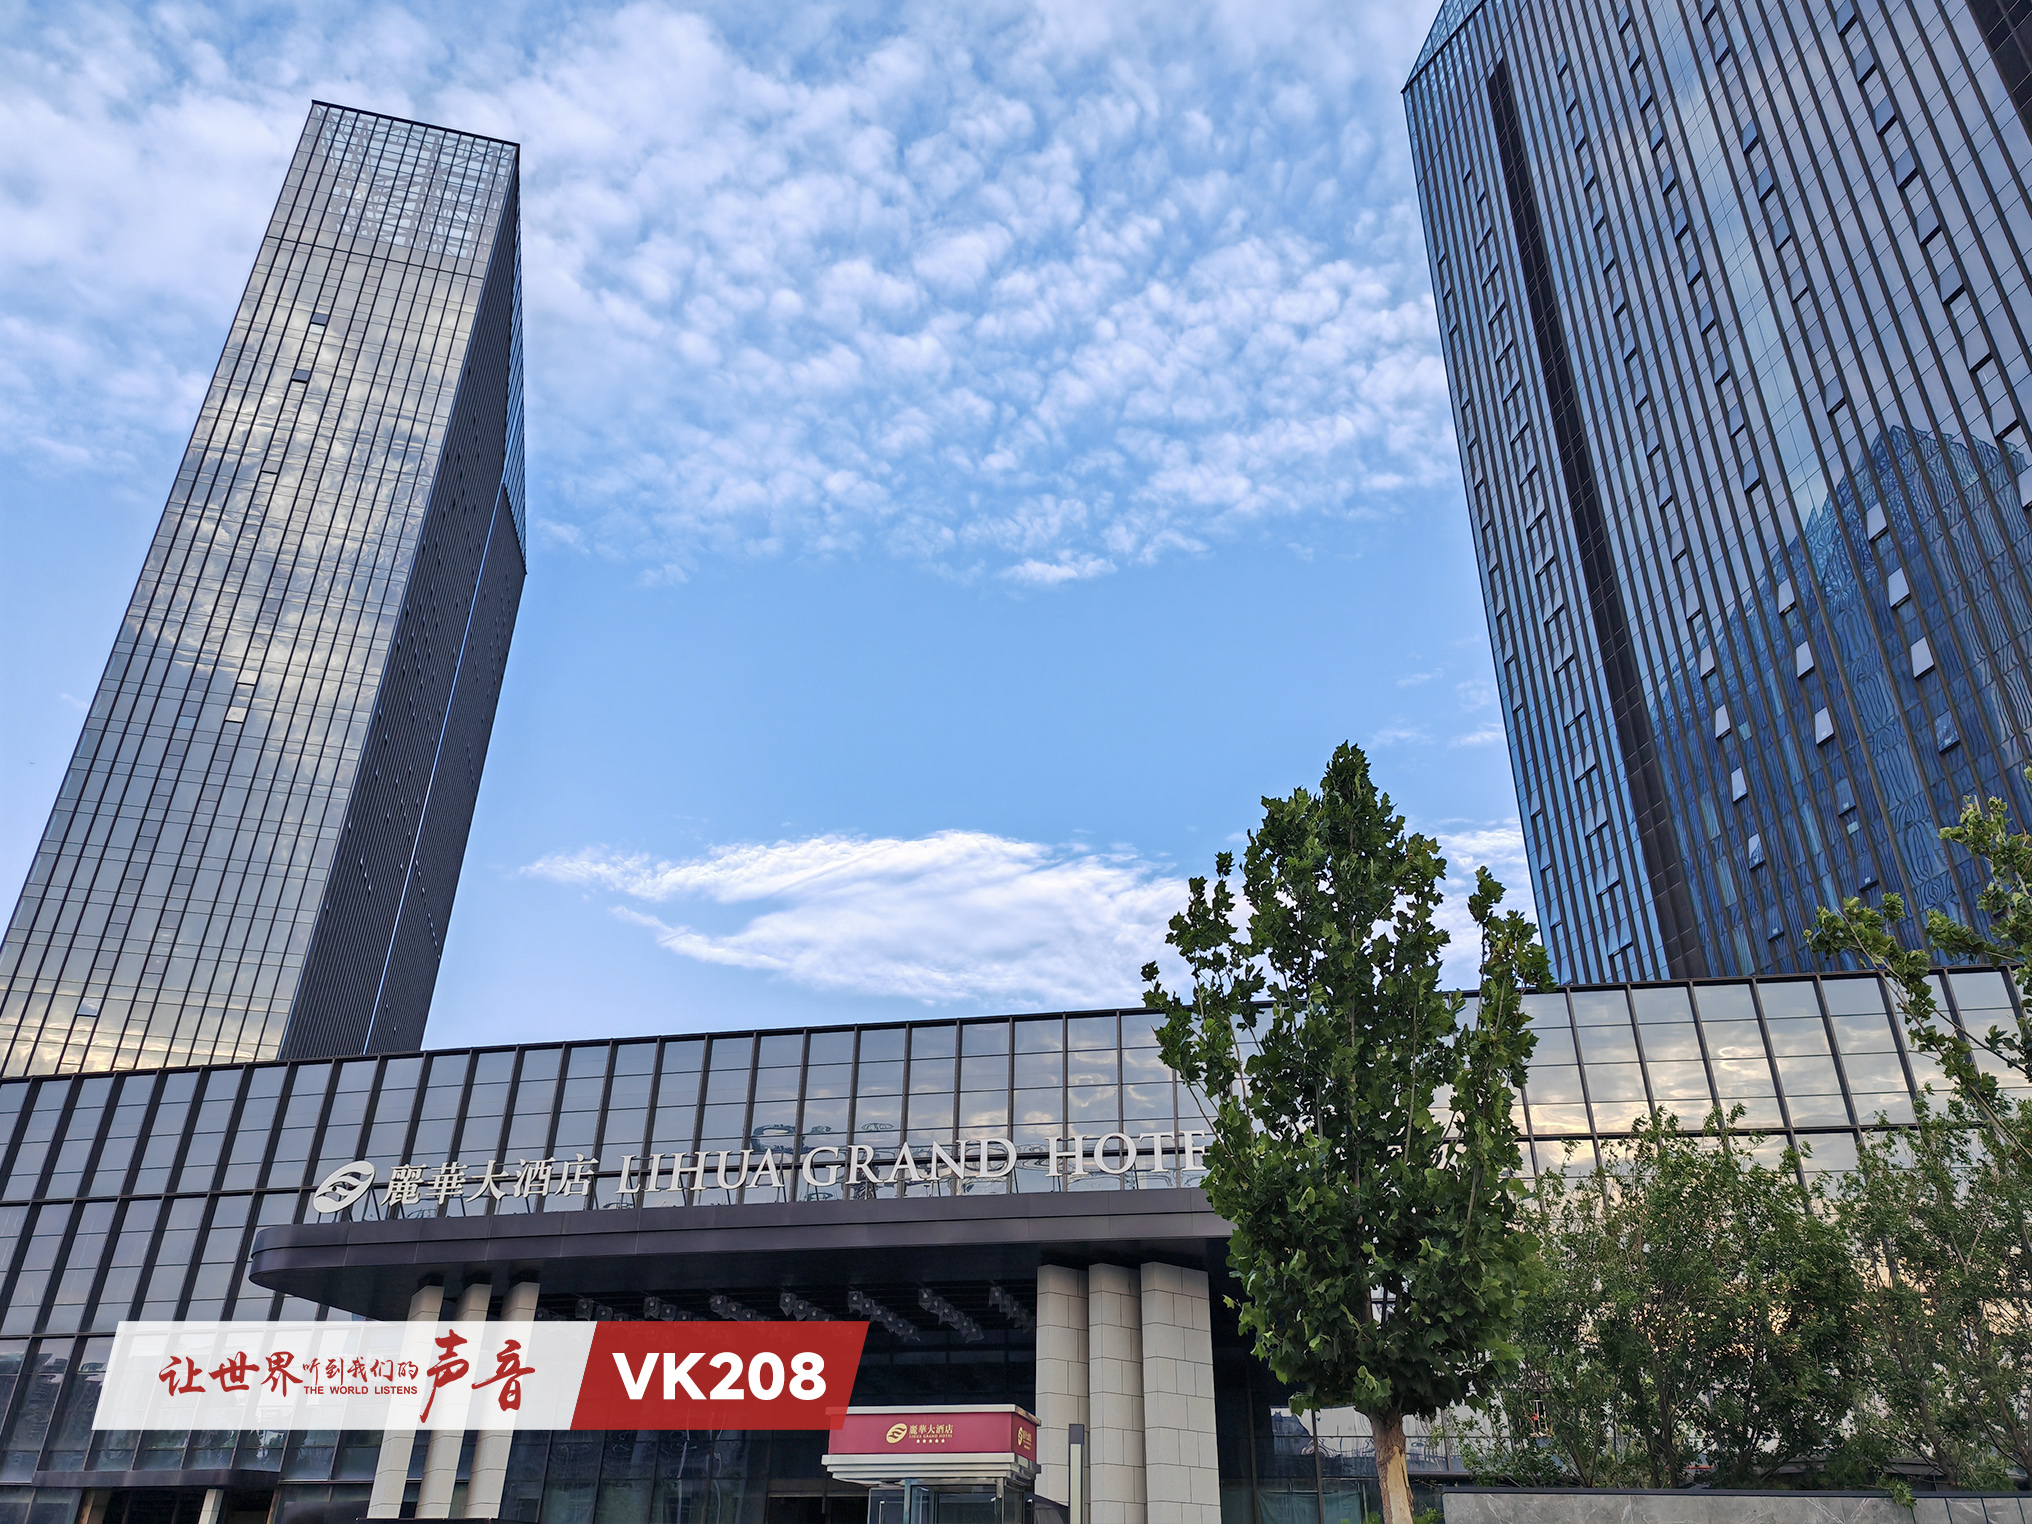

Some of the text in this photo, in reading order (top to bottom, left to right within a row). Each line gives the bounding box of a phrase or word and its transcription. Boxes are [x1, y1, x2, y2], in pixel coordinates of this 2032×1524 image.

[381, 1153, 599, 1206] 麗華大酒店
[615, 1129, 1207, 1194] LIHUA GRAND HOTE
